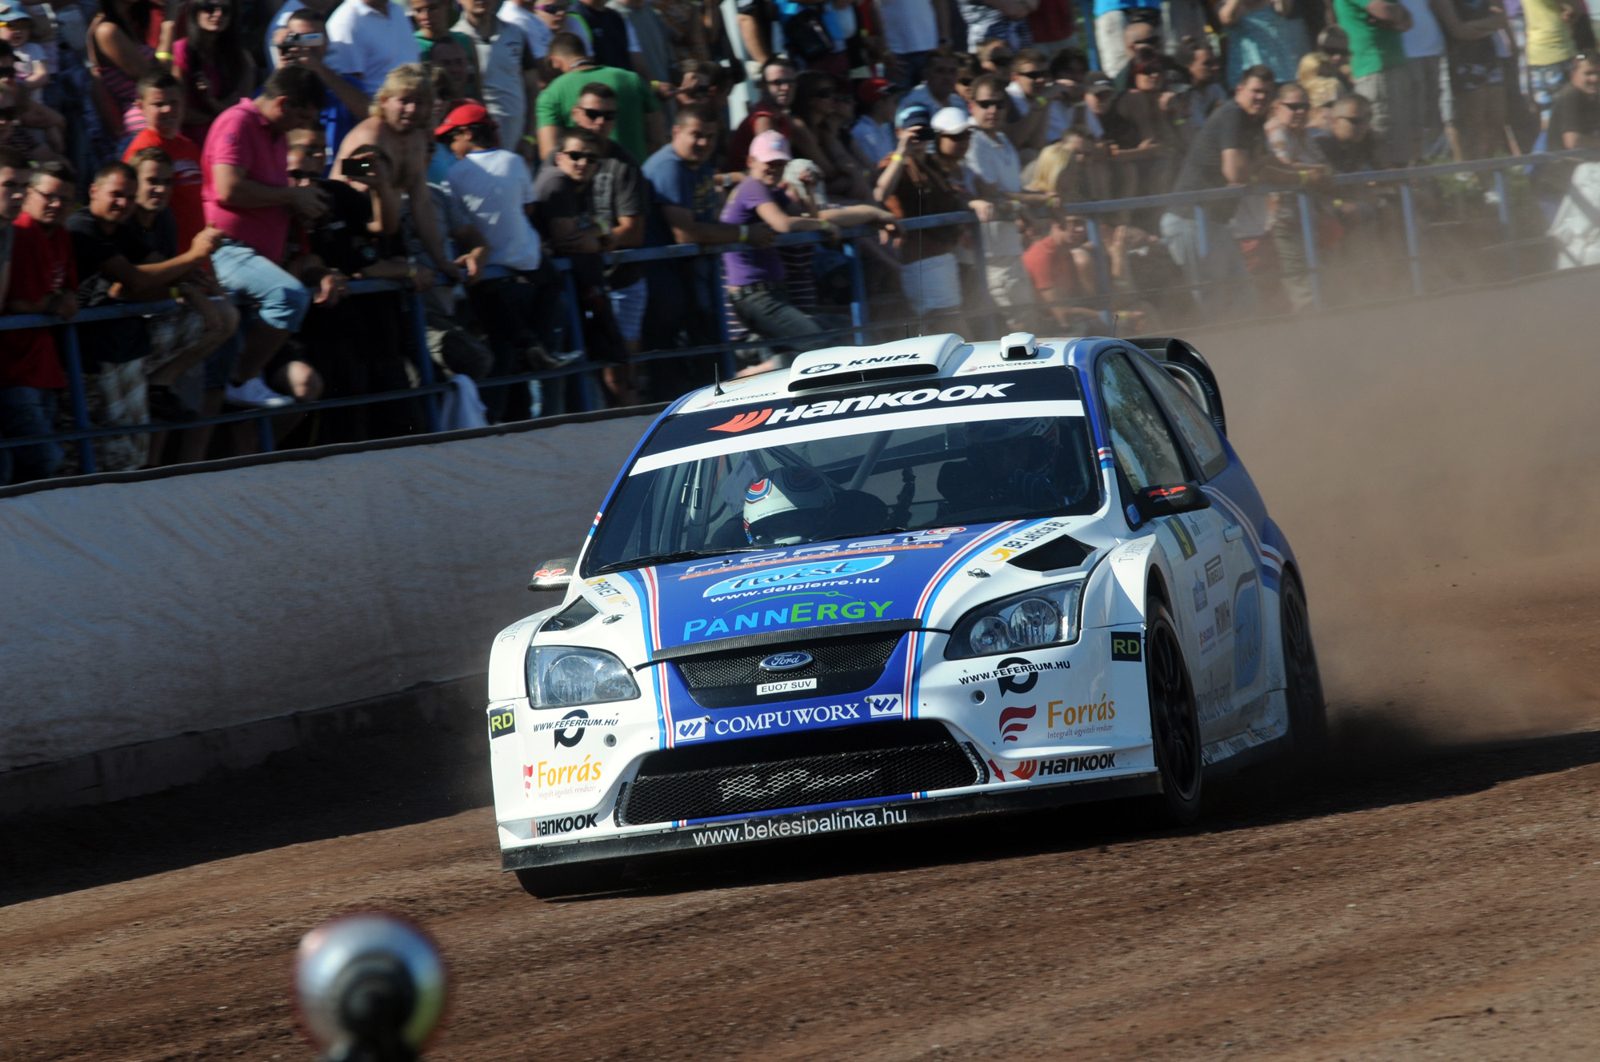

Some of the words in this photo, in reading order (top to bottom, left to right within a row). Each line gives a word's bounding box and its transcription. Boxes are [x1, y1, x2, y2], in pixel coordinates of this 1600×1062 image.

[847, 353, 921, 367] KNIPL
[710, 577, 880, 603] www.delpierre.hu
[682, 600, 893, 641] PANNERGY
[1113, 639, 1140, 655] RD
[770, 654, 801, 667] Ford
[958, 660, 1071, 685] WWW.FEFERRUM.HU
[790, 680, 812, 692] SUV
[491, 711, 514, 732] RD
[714, 702, 861, 735] COMPUWORX
[1047, 693, 1115, 728] Forrás
[533, 718, 619, 733] WWW.FEFERRUM.HU
[537, 754, 602, 788] Forrás
[693, 807, 908, 846] www.bekesipalinka.hu
